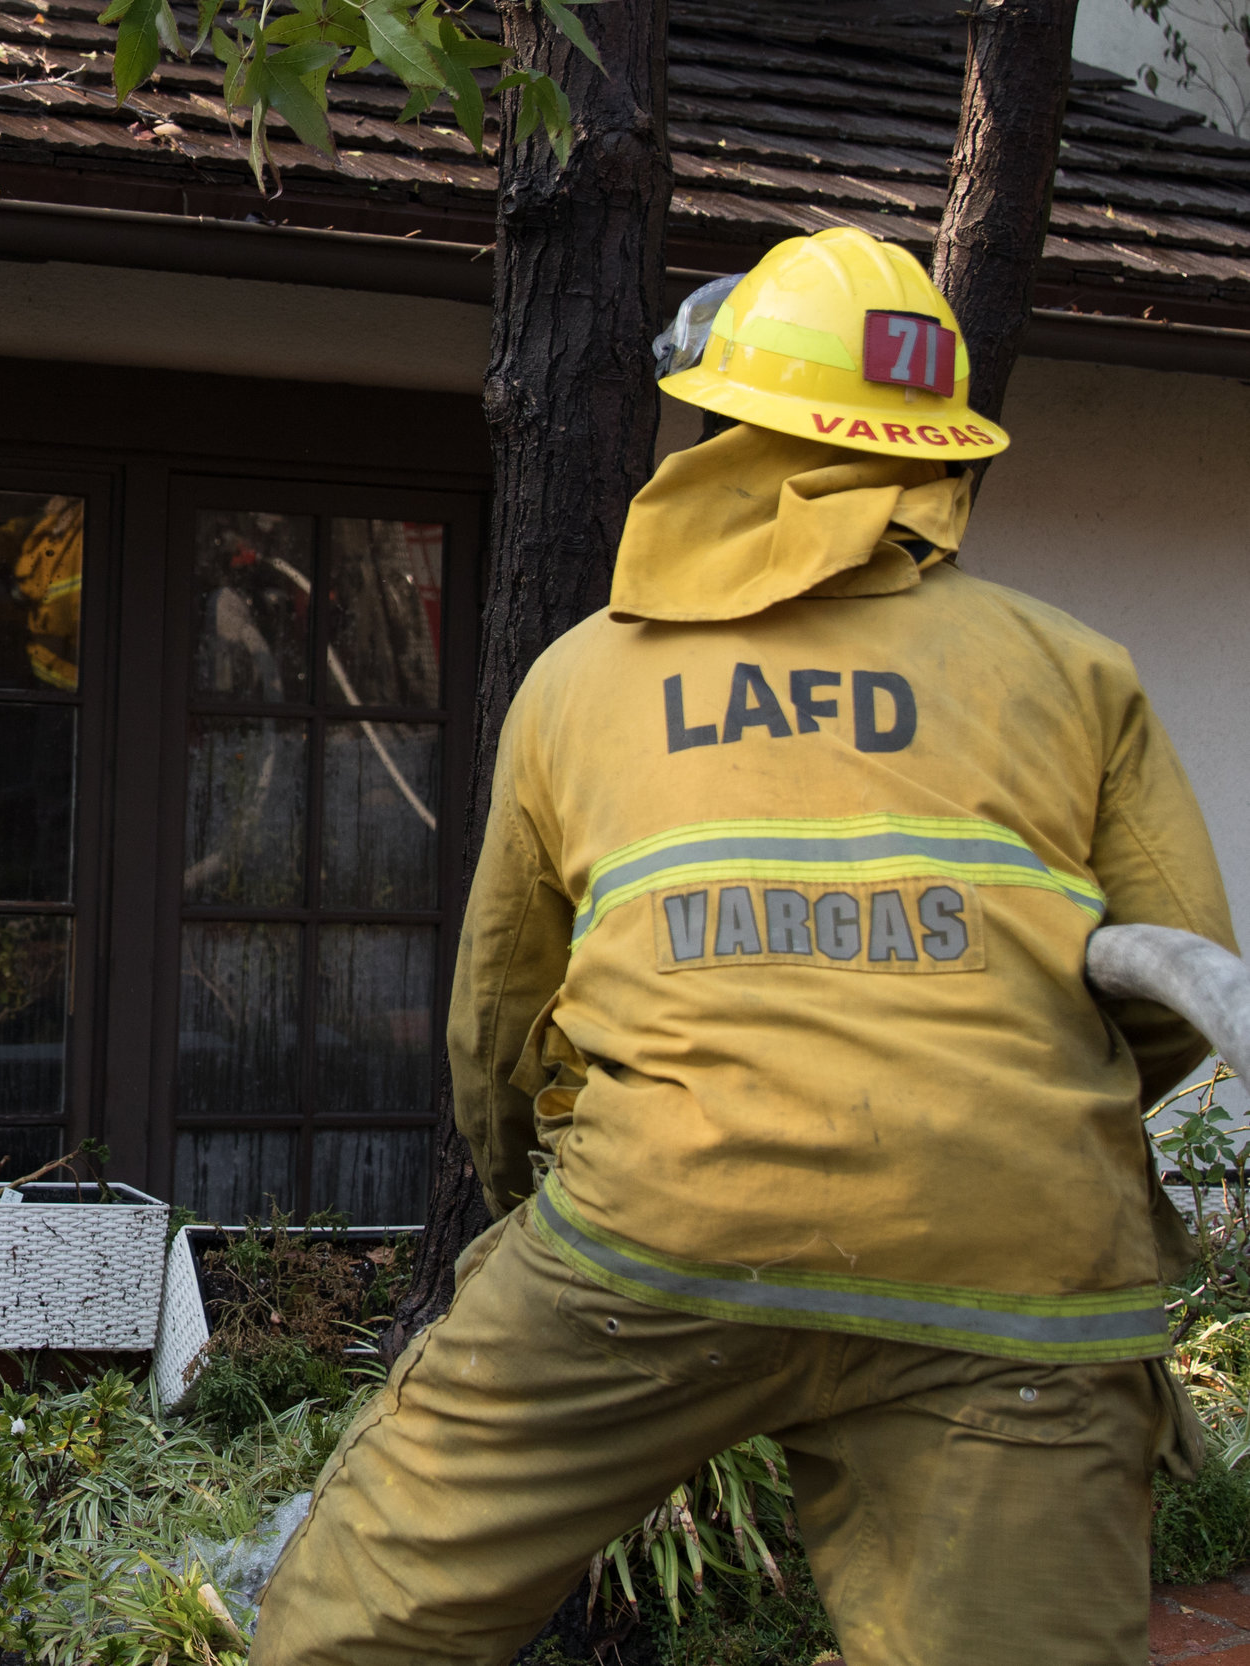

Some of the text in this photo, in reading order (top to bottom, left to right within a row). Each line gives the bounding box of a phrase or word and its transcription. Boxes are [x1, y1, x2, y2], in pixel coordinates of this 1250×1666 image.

[888, 317, 937, 387] 71
[811, 412, 995, 447] VARGAS
[662, 661, 918, 755] LAFD
[662, 885, 970, 963] VARGAS
